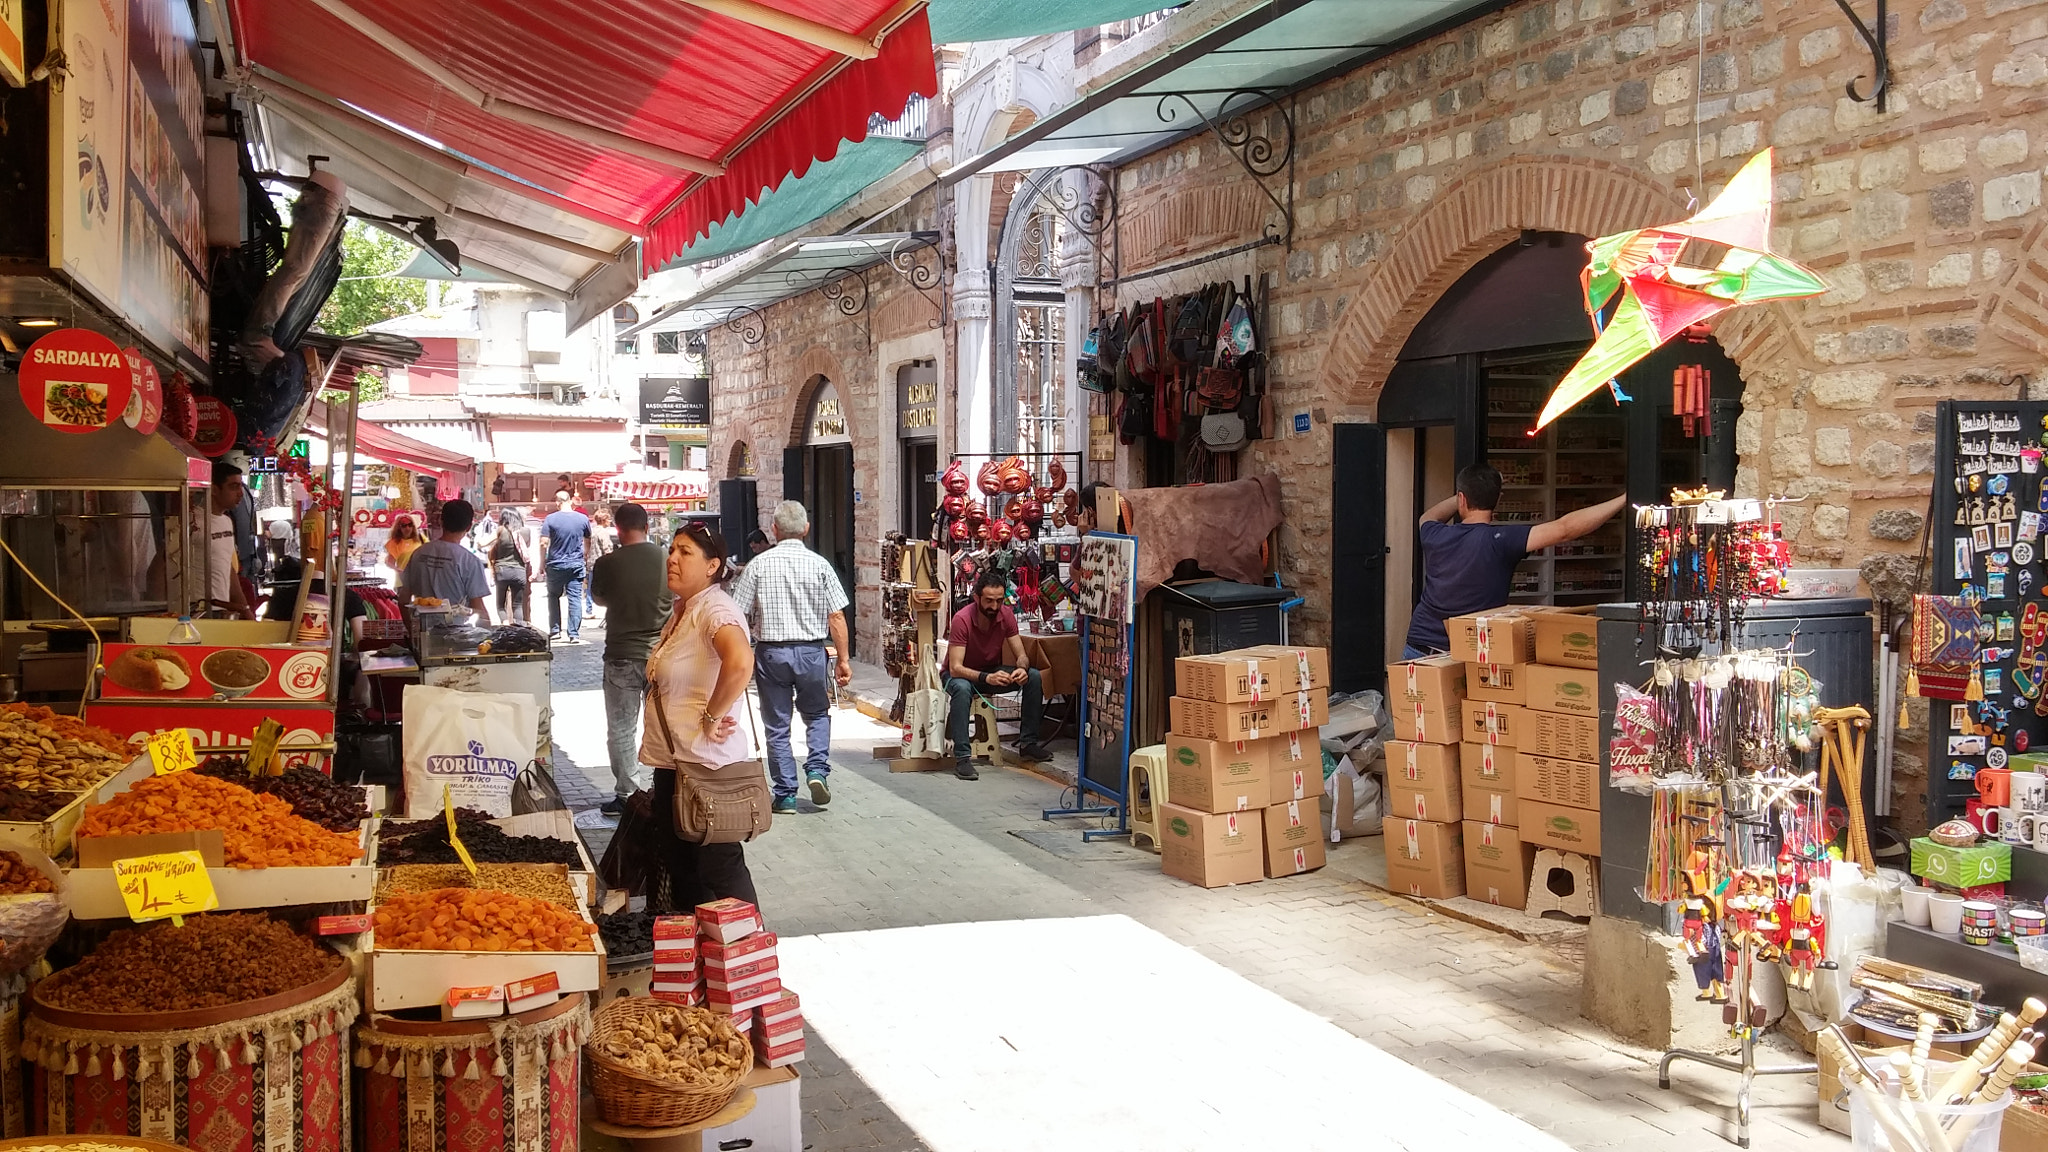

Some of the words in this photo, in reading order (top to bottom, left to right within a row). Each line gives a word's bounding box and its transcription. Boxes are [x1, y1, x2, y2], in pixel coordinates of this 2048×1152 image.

[33, 348, 121, 369] SARDALYA
[430, 757, 517, 780] YORULMAZ
[461, 774, 491, 783] TRİKO
[140, 877, 174, 912] 4
